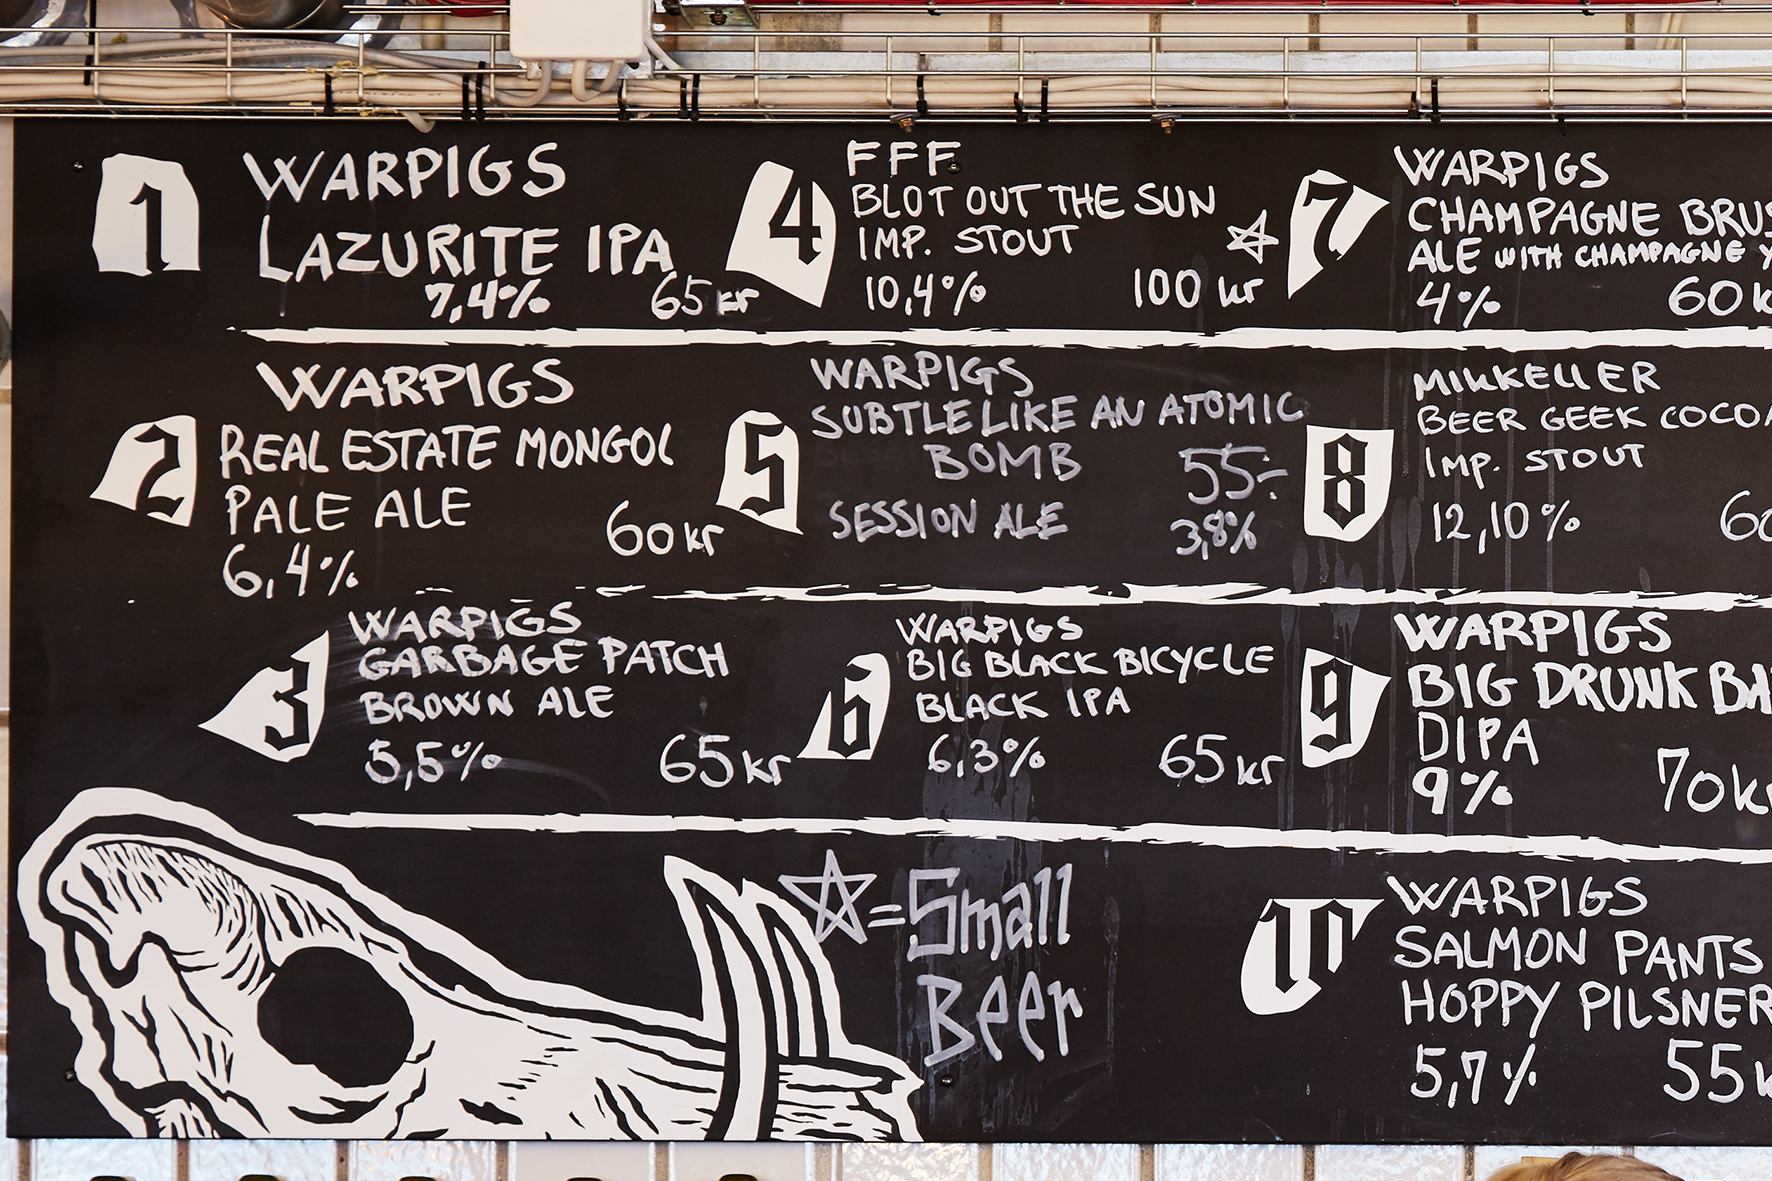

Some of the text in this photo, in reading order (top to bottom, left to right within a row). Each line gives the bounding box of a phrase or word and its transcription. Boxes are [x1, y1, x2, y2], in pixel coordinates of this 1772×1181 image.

[242, 142, 566, 203] WARPIGS
[846, 139, 962, 177] FFF
[1393, 145, 1610, 192] WARPIGS
[851, 182, 1216, 220] BLOT OUT THE SUN
[1407, 195, 1661, 237] CHAMPAGNE
[259, 214, 675, 283] LAZURITE IPA
[953, 224, 1080, 257] STOUT
[1407, 236, 1483, 275] ALE
[1494, 242, 1563, 271] WITH
[1574, 239, 1746, 268] CHAMPAGNE
[1134, 267, 1202, 309] 100
[255, 358, 575, 412] WARPIGS
[810, 350, 1034, 398] WARPIGS
[1413, 360, 1661, 402] MIKKELLER
[1090, 389, 1304, 430] AN ATOMIC
[1417, 404, 1527, 436] BEER
[1540, 404, 1647, 432] GEEK
[219, 422, 675, 479] REAL ESTATE MONGOL
[922, 440, 1082, 482] BOMB
[1524, 443, 1645, 473] STOUT
[224, 484, 472, 536] PALE ALE
[829, 497, 1069, 543] SESSION ALE
[347, 598, 582, 646] WARPIGS
[895, 612, 1084, 647] WARPIGS
[1393, 608, 1672, 657] WARPIGS
[357, 635, 730, 681] GARBAGE PATCH
[906, 642, 1274, 685] BIG BLACK BICYCLE
[358, 684, 614, 725] BROWN ALE
[915, 686, 1131, 724] BLACK IPA
[1407, 661, 1519, 709] BIG
[1531, 660, 1699, 713] DRUNK
[1417, 710, 1540, 766] DIPA
[906, 862, 1073, 963] Small
[1386, 875, 1648, 919] WARPIGS
[1393, 925, 1764, 983] SALMON PANTS
[916, 970, 1084, 1068] Beer
[1401, 977, 1561, 1039] HOPPY
